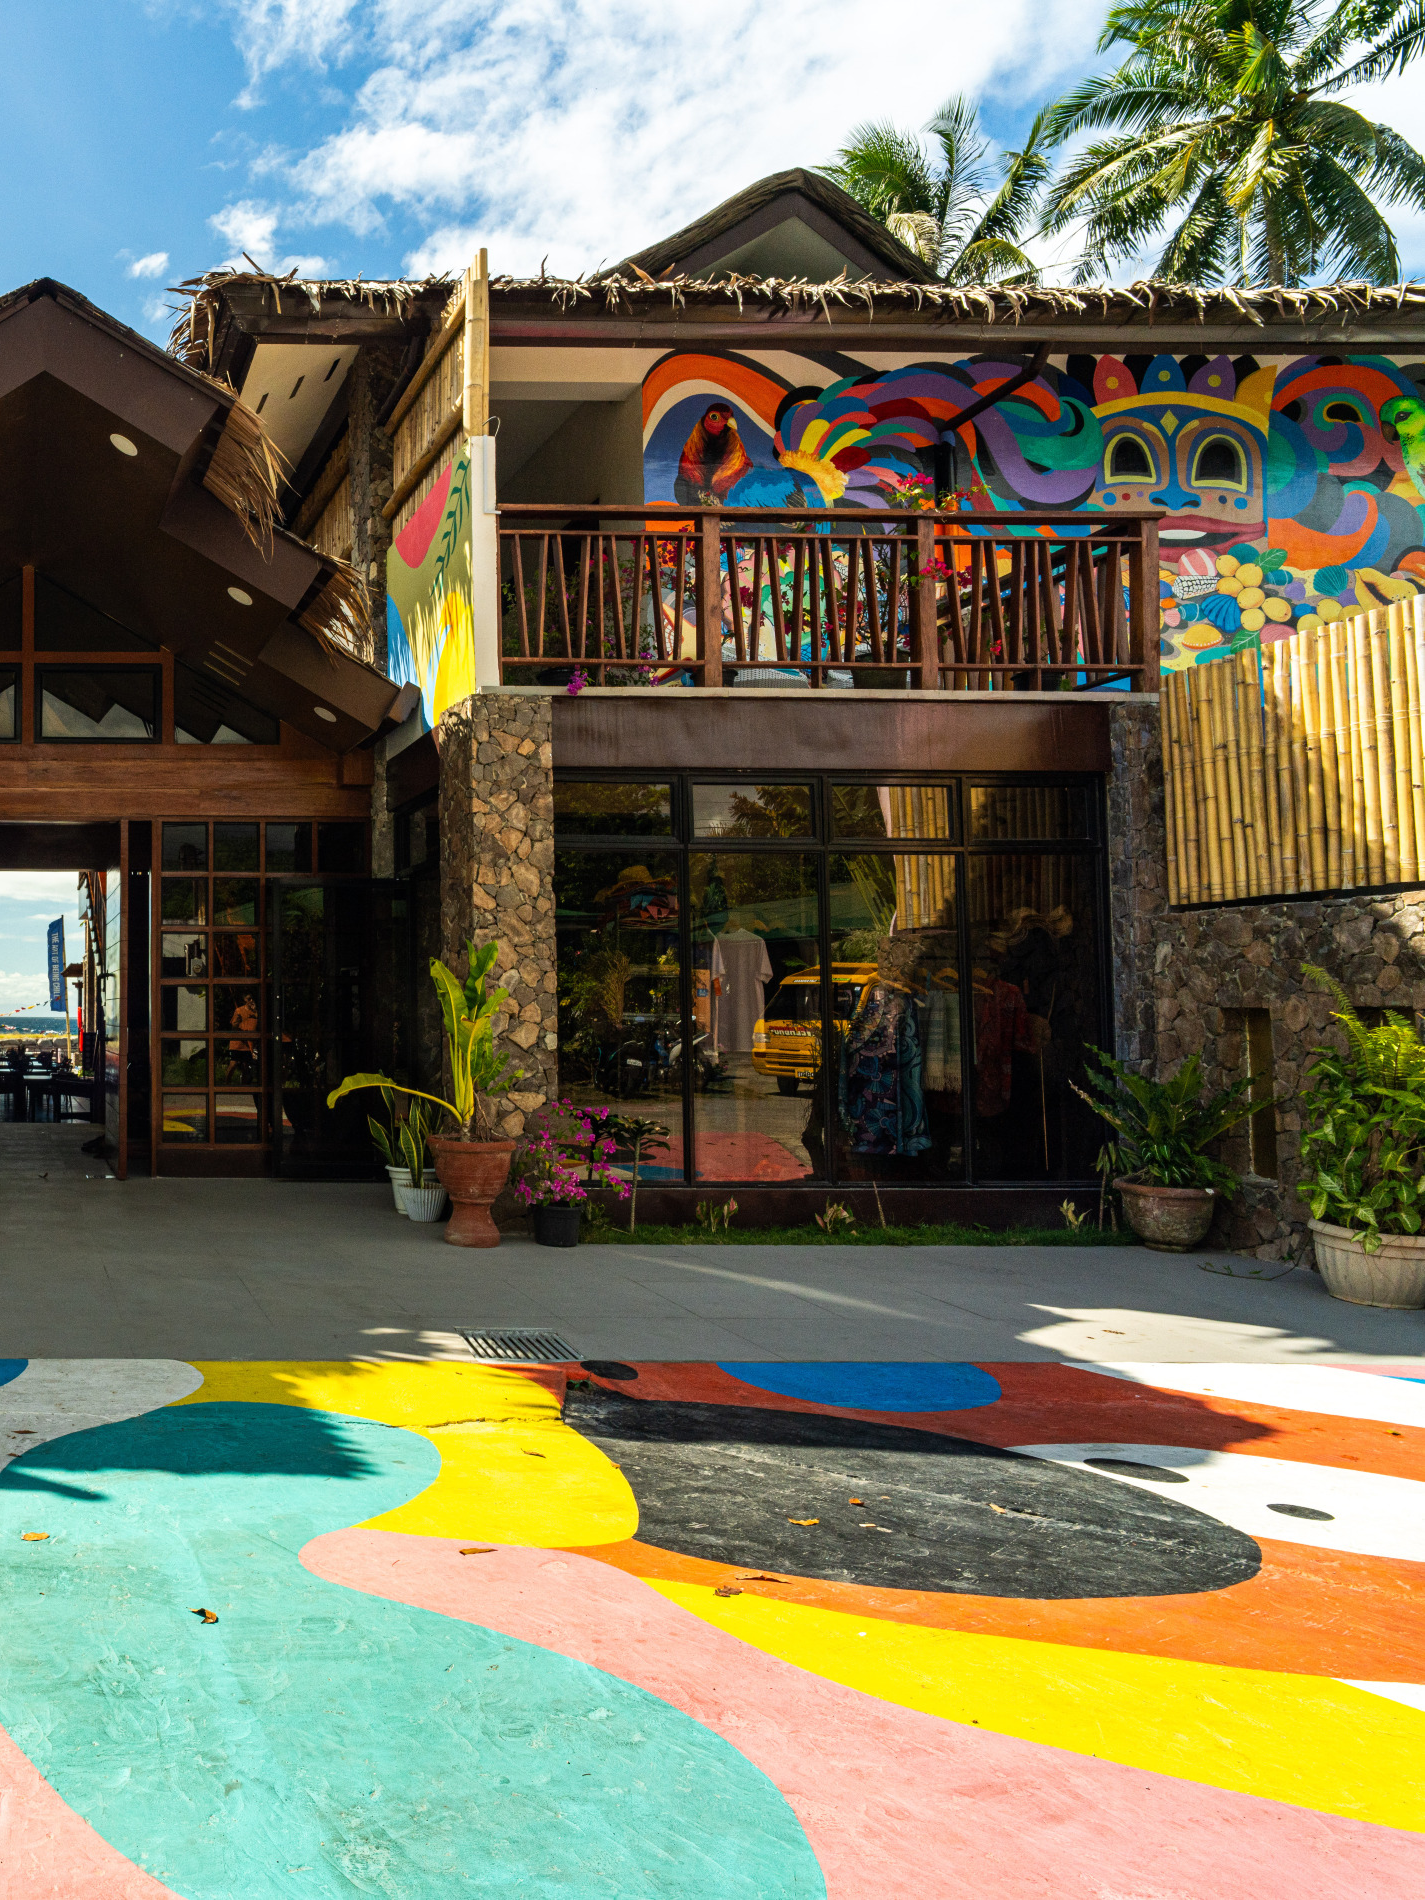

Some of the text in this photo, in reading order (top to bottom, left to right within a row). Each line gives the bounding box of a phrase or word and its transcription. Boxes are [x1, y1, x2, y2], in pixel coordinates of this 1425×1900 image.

[51, 933, 59, 944] THE
[51, 956, 59, 964] OF
[52, 965, 60, 981] BEING
[53, 982, 61, 998] CHILL
